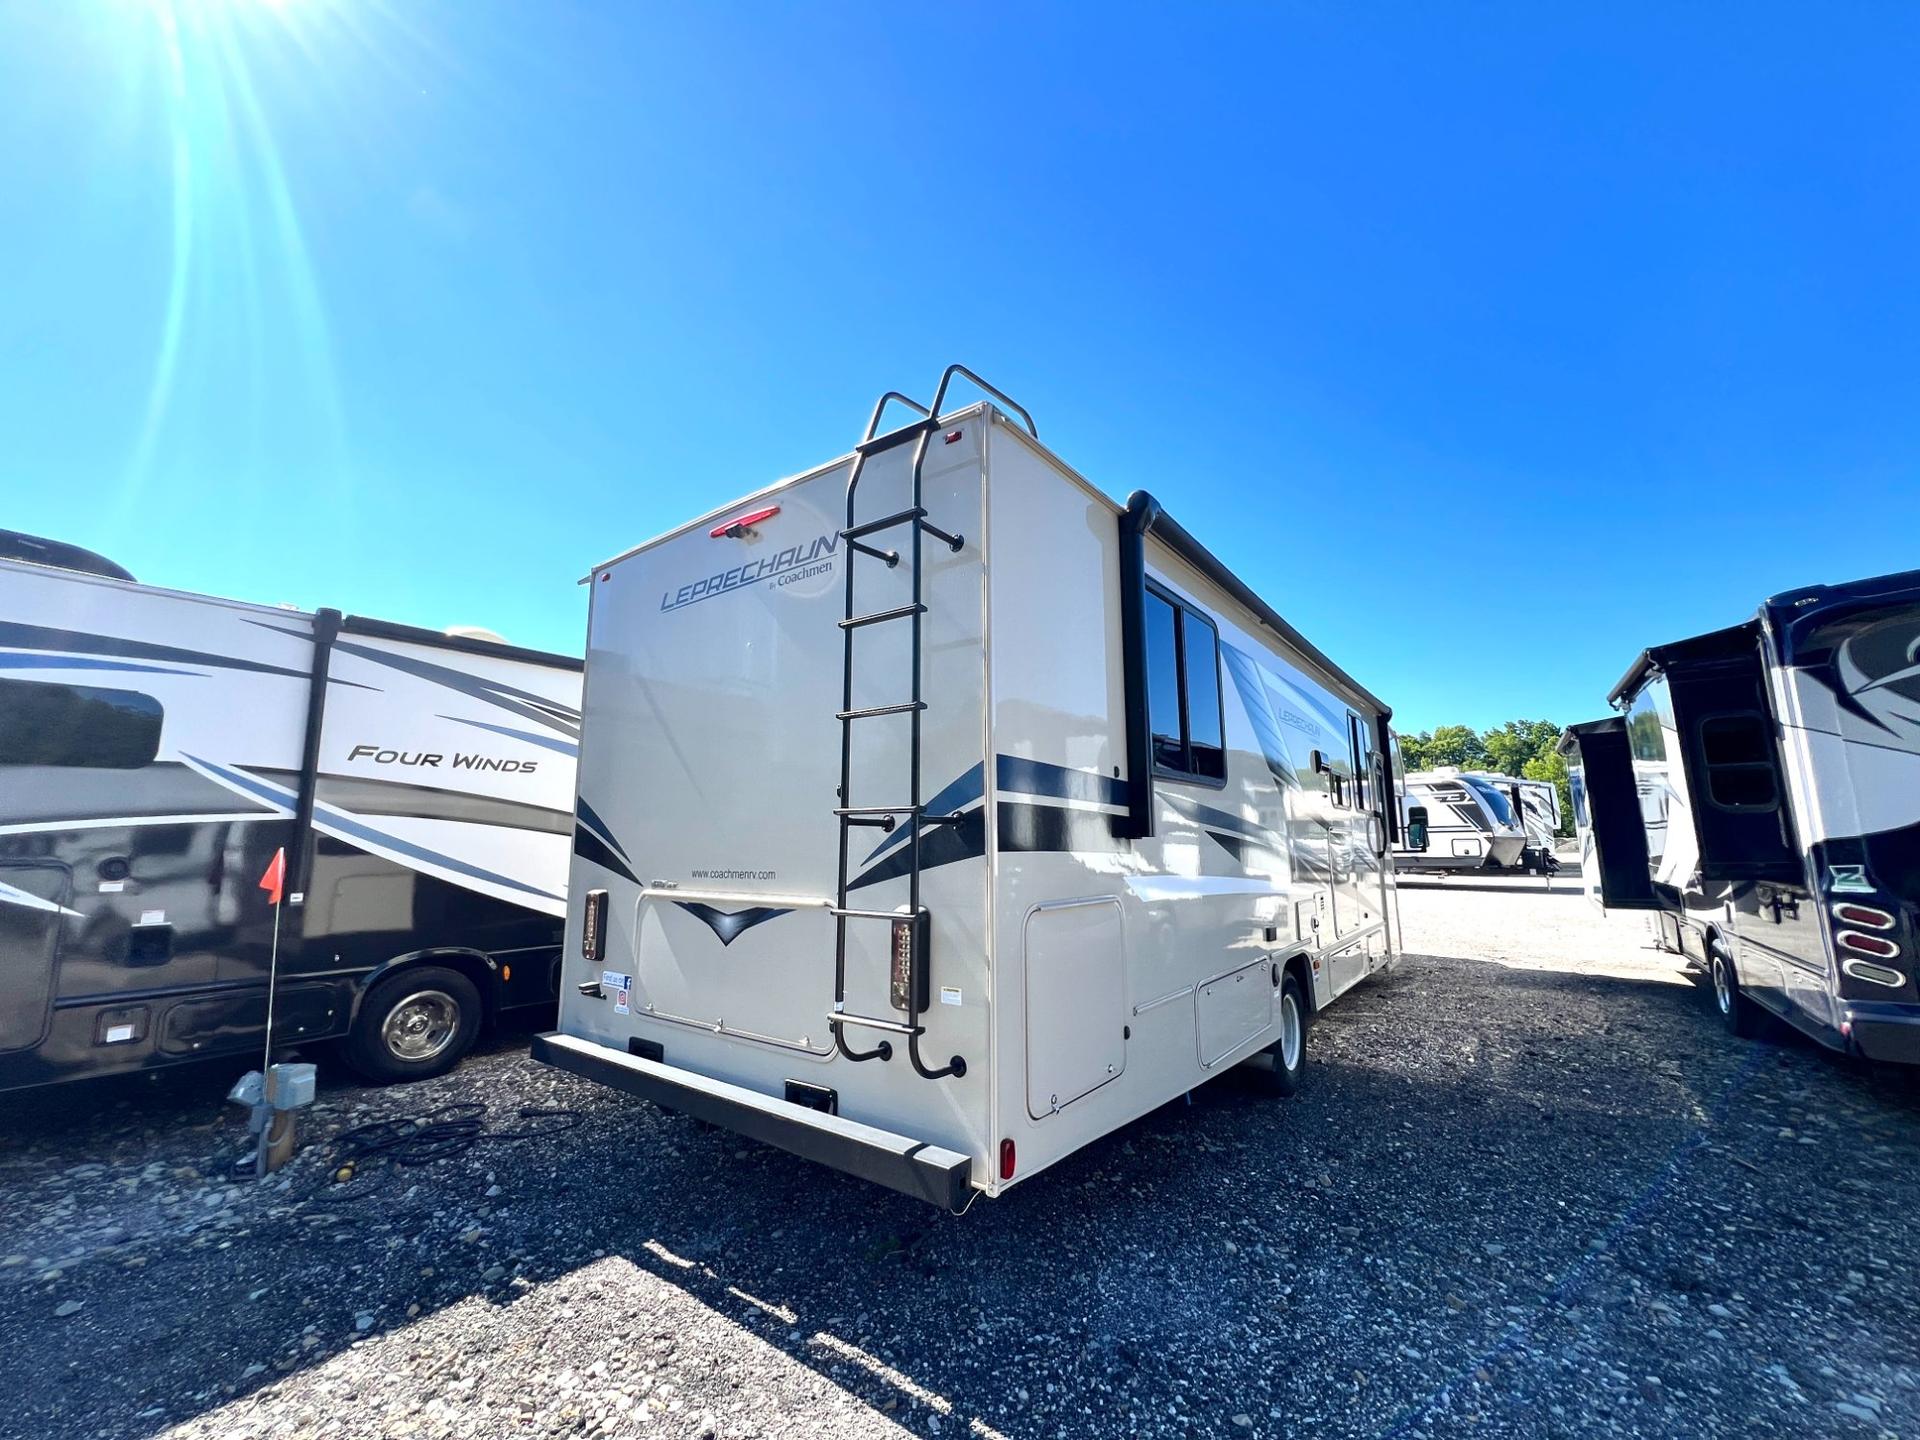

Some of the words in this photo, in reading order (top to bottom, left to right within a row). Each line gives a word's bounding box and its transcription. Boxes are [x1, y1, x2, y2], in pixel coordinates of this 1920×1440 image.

[660, 531, 840, 611] LEPRECHAUN
[777, 562, 832, 586] Coachmen
[347, 745, 444, 768] FOUR
[452, 752, 538, 774] WINDS
[691, 869, 777, 881] www.coachmenrv.com
